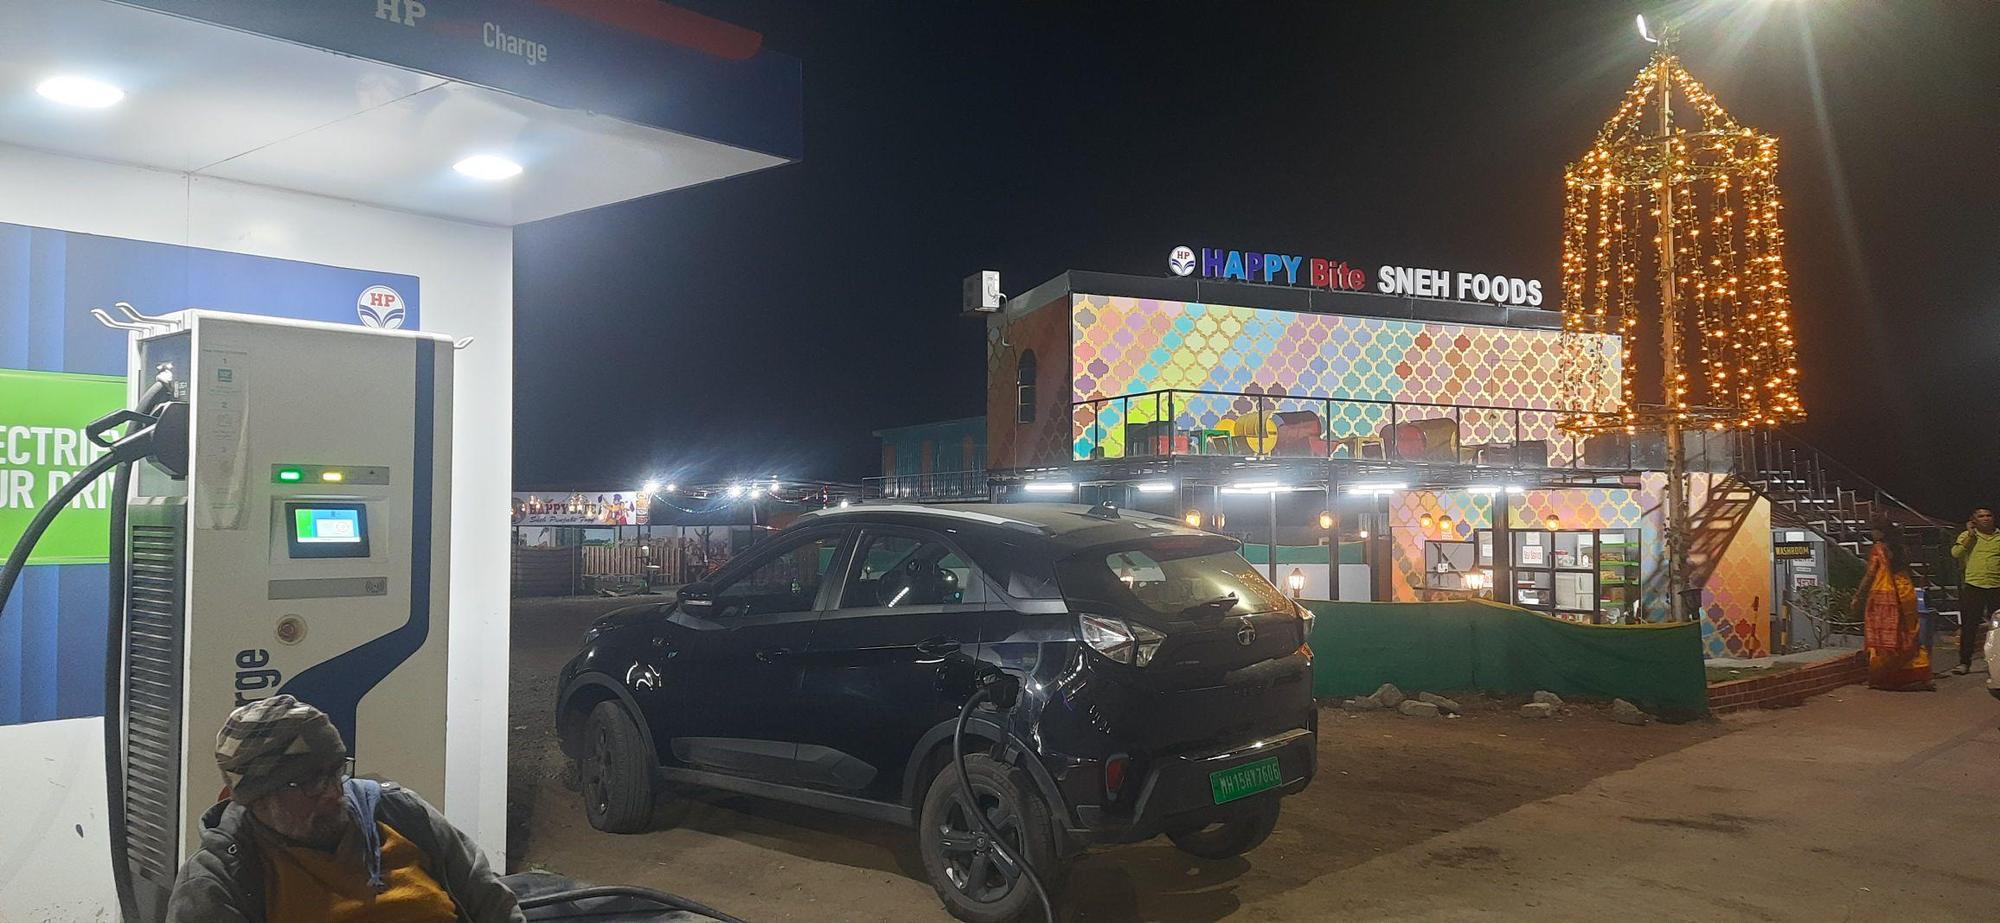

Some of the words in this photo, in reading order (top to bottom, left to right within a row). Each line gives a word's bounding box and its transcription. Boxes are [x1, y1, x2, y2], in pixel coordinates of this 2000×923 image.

[375, 0, 426, 27] HP
[483, 22, 547, 65] Charge
[370, 292, 396, 307] HP
[1202, 248, 1302, 284] HAPPY
[1310, 258, 1365, 290] Bite
[1377, 265, 1450, 298] SNEH
[1457, 272, 1543, 306] FOODS
[1220, 763, 1281, 797] MH15HY7606
